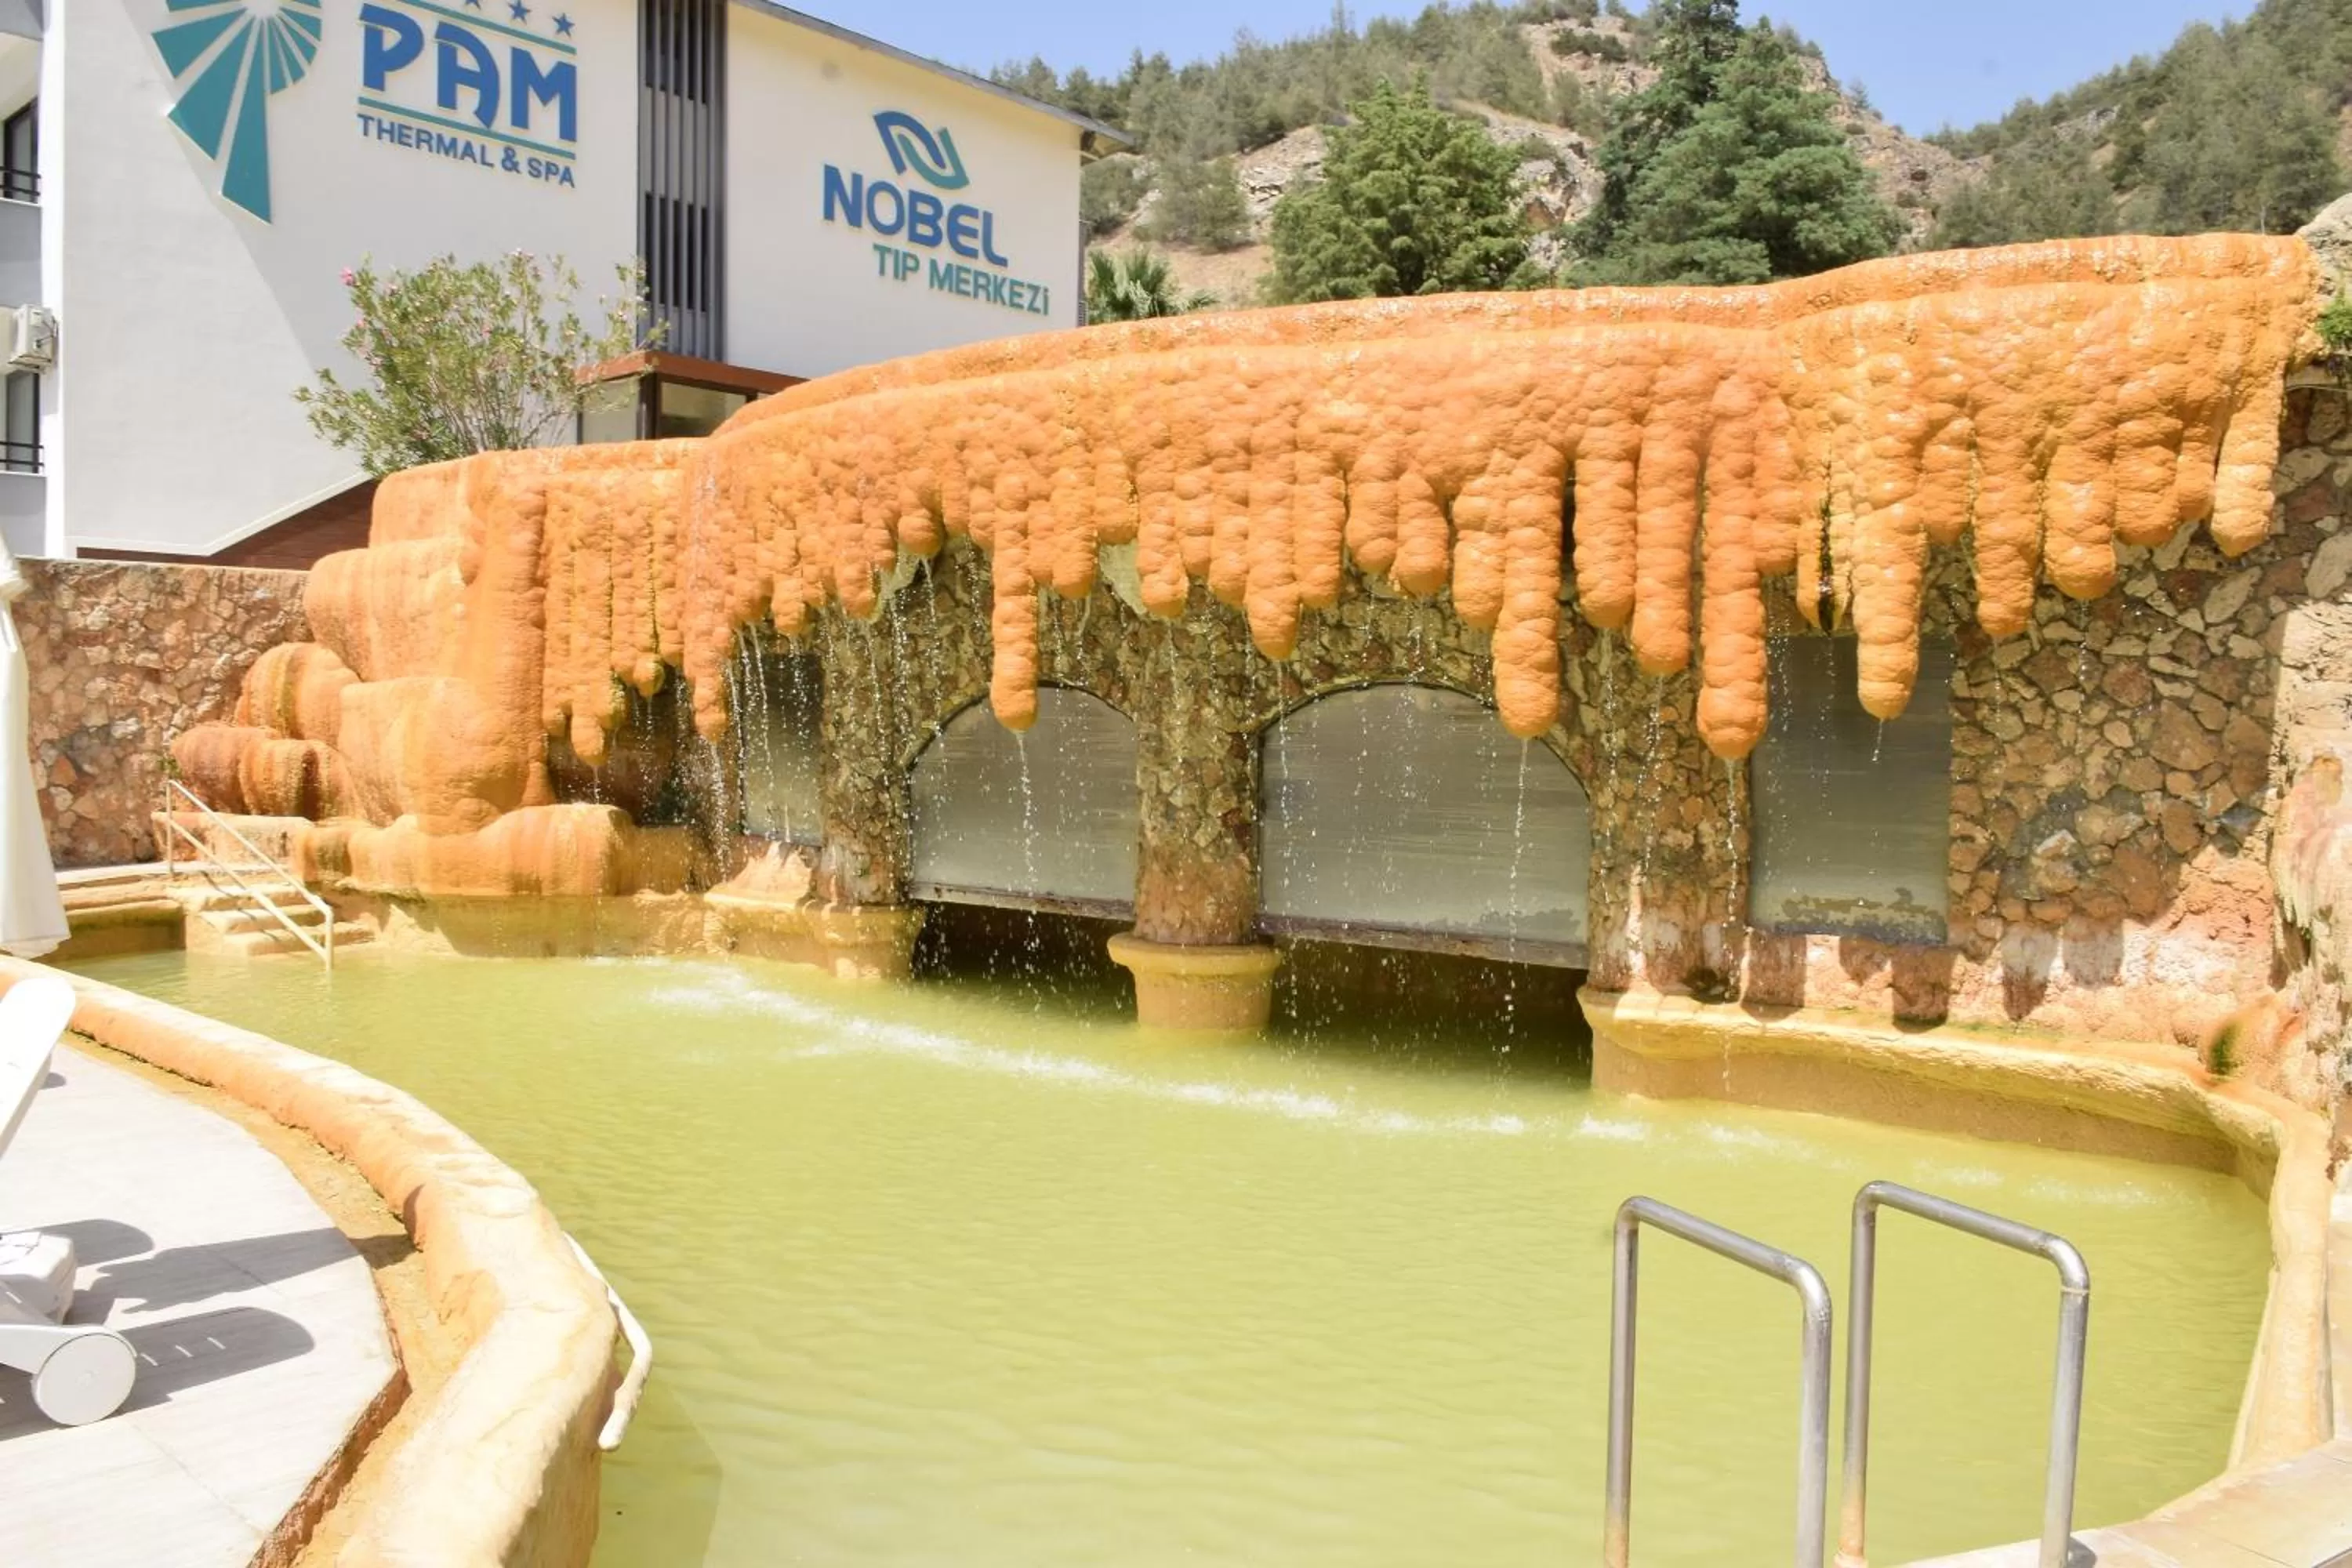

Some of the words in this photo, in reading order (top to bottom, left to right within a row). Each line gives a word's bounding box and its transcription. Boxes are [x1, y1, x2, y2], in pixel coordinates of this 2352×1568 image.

[359, 3, 577, 143] PAM
[357, 114, 495, 169] THERMAL
[501, 146, 521, 174] &
[527, 158, 575, 188] SPA
[823, 163, 1008, 267] NOBEL
[873, 243, 920, 281] TIP
